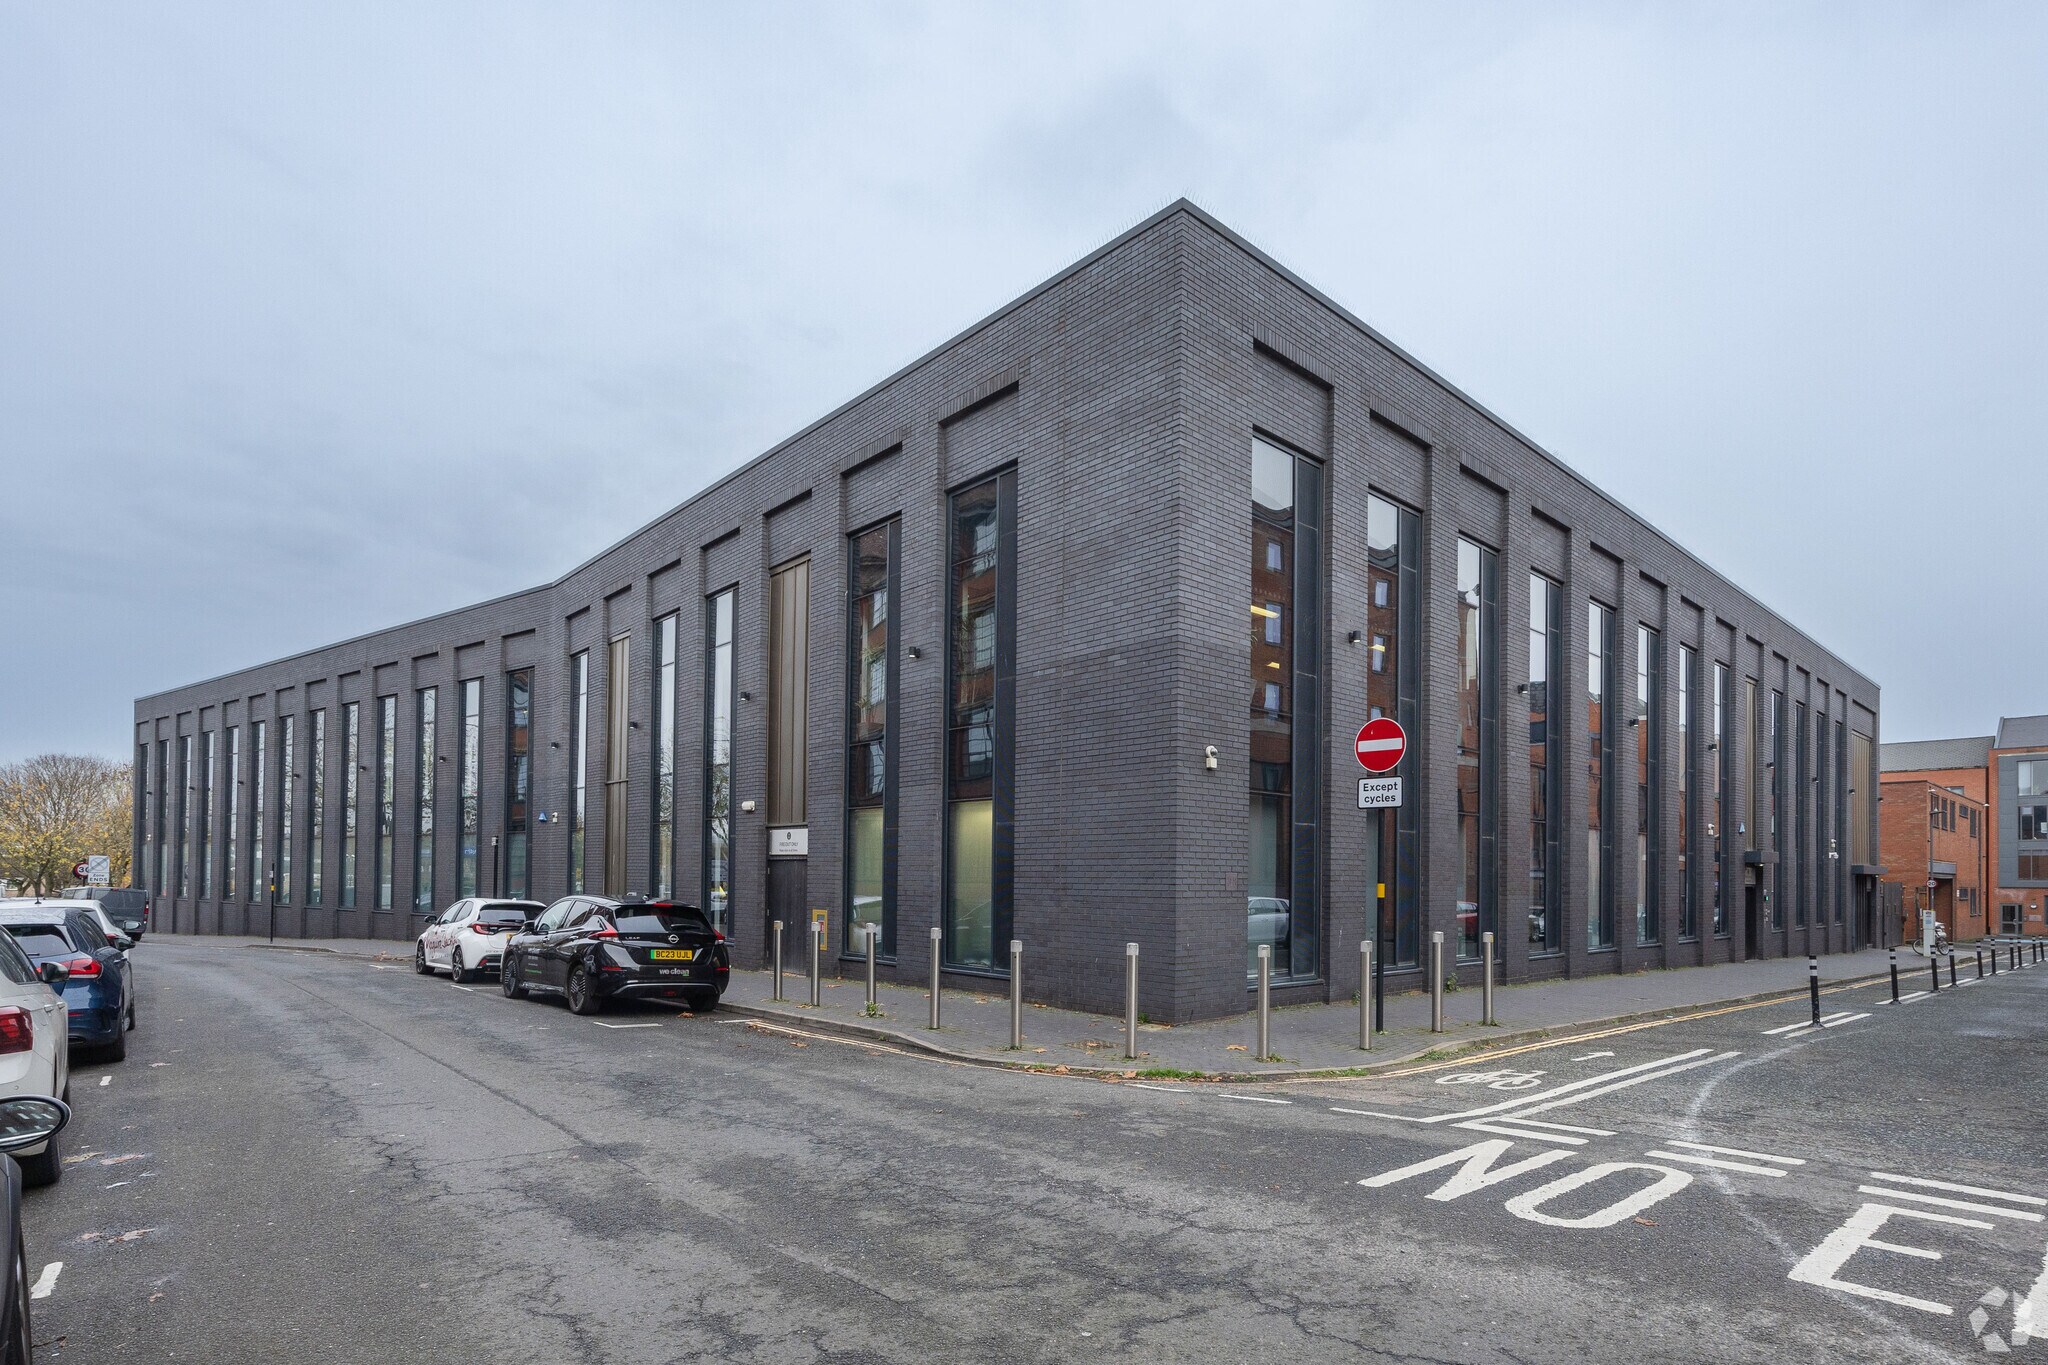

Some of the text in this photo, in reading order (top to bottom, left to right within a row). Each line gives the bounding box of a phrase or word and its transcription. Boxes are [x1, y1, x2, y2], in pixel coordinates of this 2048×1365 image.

[1363, 782, 1398, 793] Except
[1364, 793, 1396, 804] cycles
[671, 968, 689, 976] clean
[1358, 1140, 1693, 1229] NO
